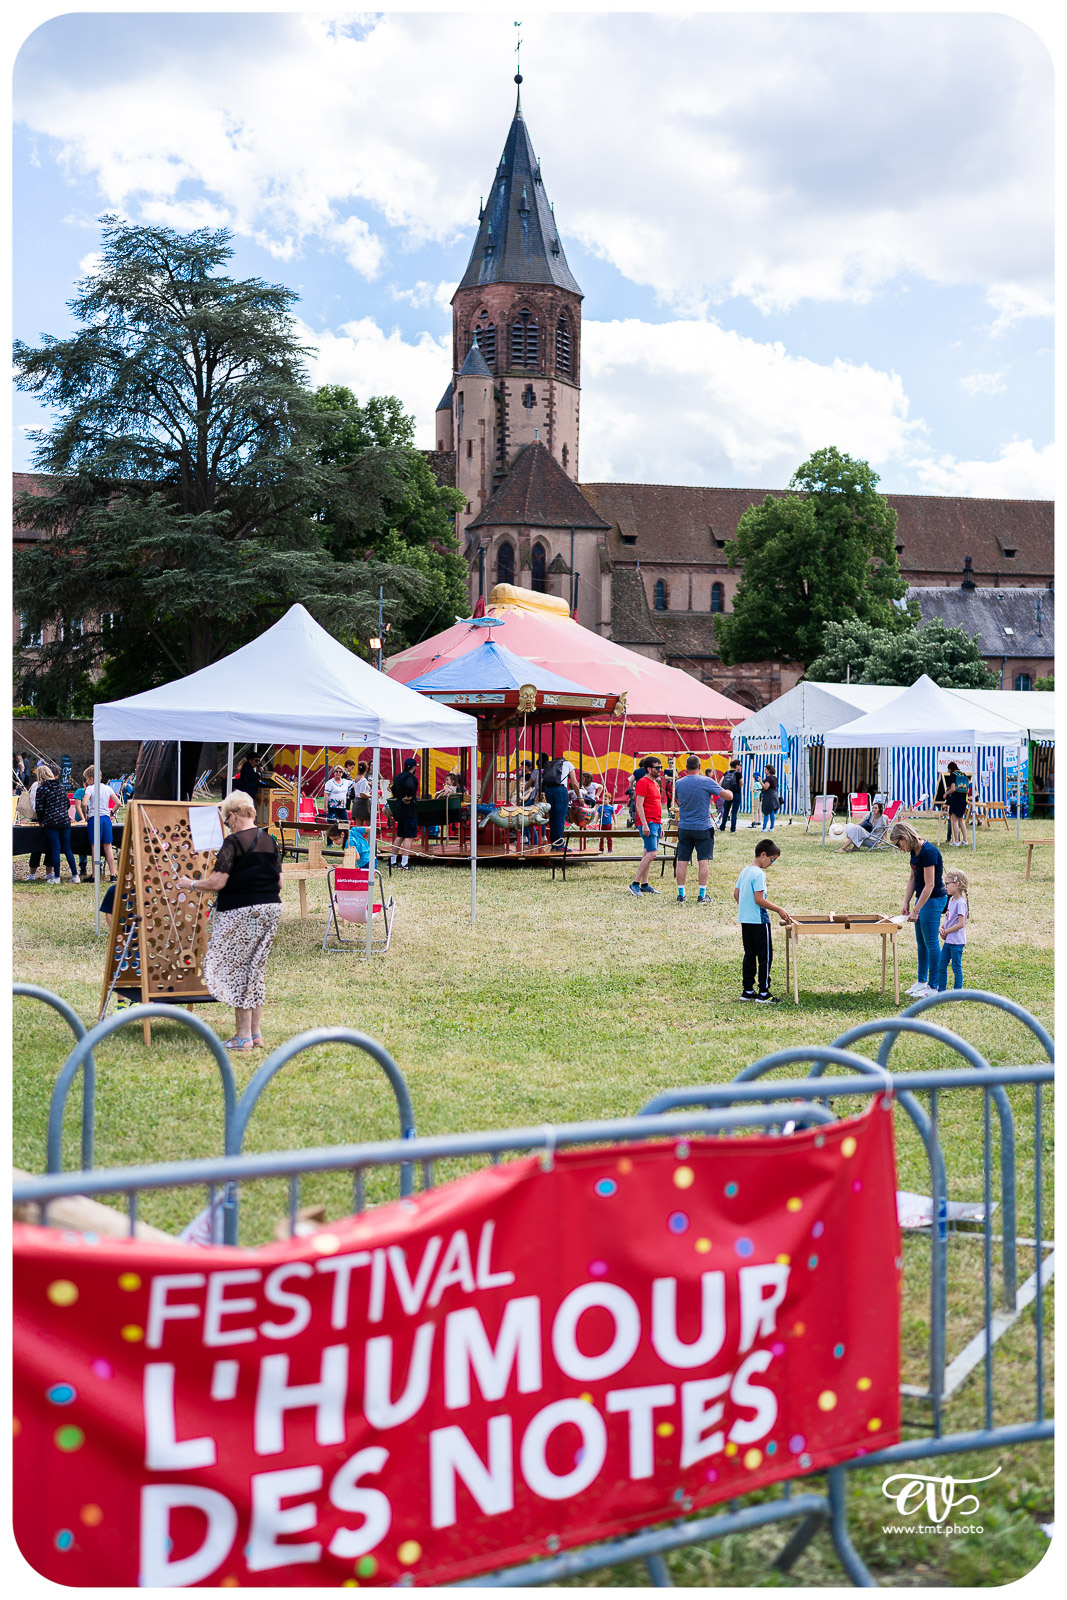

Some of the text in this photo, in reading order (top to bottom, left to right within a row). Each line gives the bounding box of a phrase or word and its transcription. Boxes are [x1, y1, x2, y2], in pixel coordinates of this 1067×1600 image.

[144, 1262, 792, 1472] L'HUMOUR
[145, 1220, 516, 1350] FESTIVAL
[139, 1349, 778, 1588] DES NOTES
